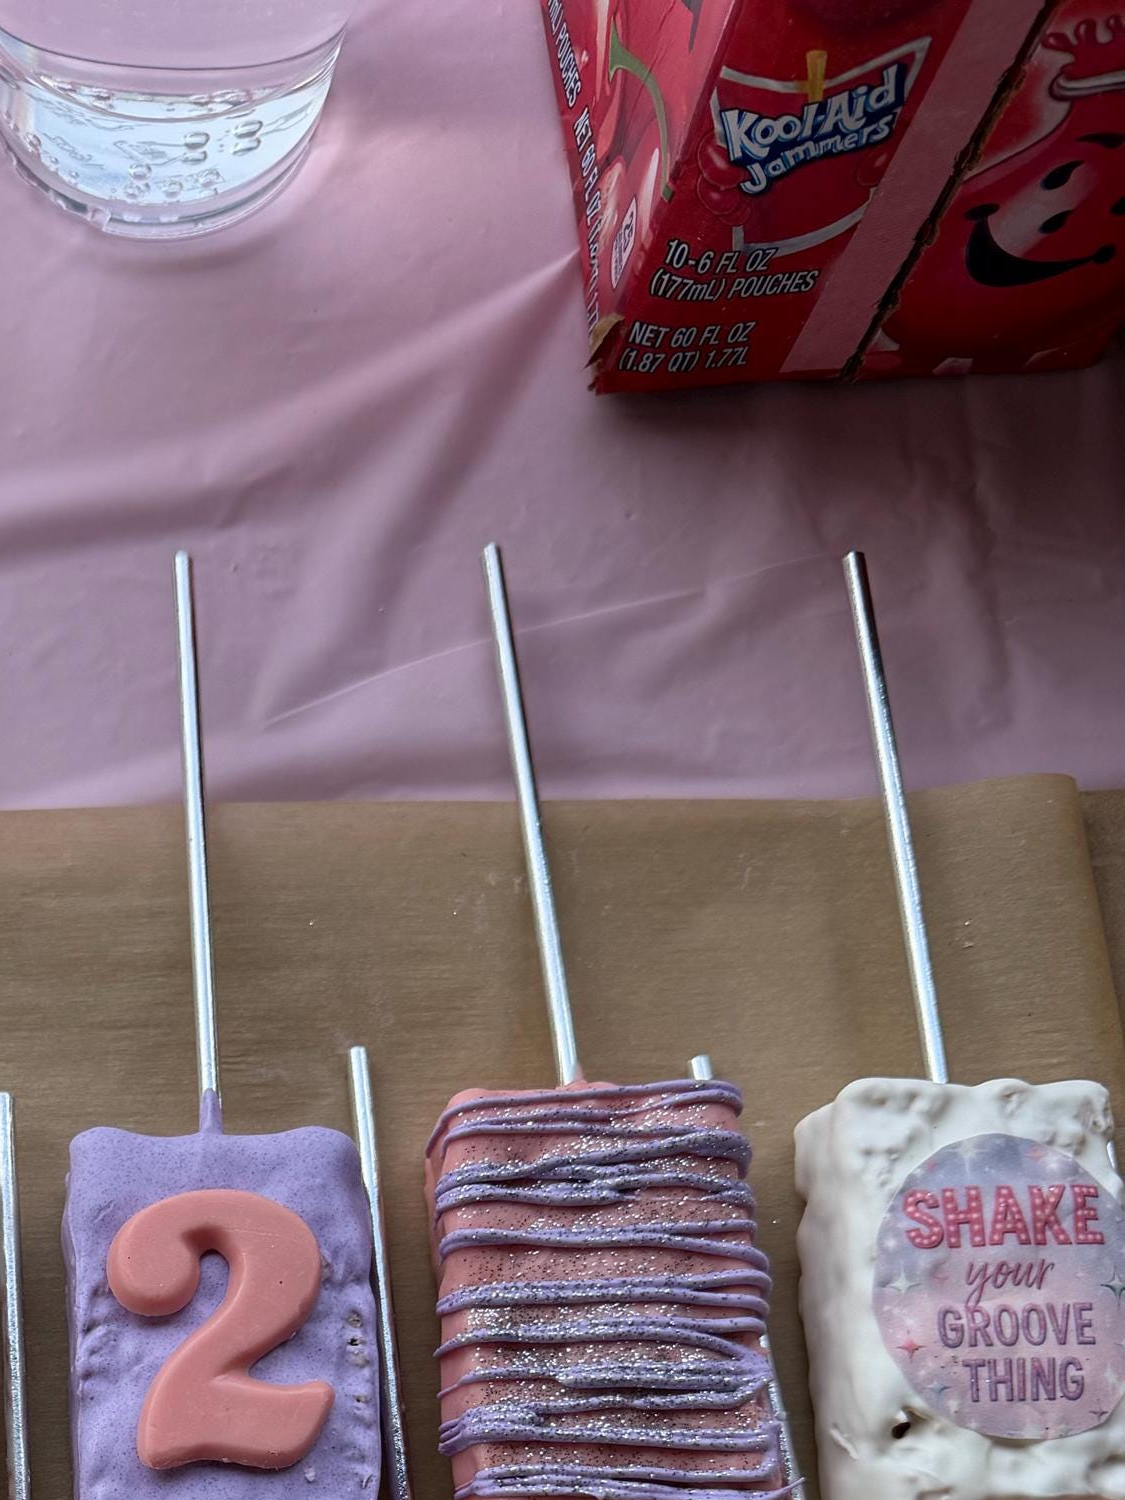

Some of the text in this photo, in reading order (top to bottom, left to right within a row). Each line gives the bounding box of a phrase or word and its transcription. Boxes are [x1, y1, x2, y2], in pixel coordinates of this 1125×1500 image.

[721, 62, 902, 162] Kool-Aid
[740, 113, 894, 195] Jammers
[650, 268, 819, 301] (177mL) POUCHES
[715, 252, 738, 274] FL
[745, 248, 777, 272] OZ
[628, 321, 756, 348] NET 60 FL OZ
[619, 346, 749, 373] (1.87 QT) 1.77L
[902, 1183, 1105, 1249] SHAKE
[964, 1257, 1056, 1305] your
[106, 1188, 336, 1471] 2
[937, 1302, 1097, 1349] GROOVE
[961, 1356, 1085, 1403] THING
